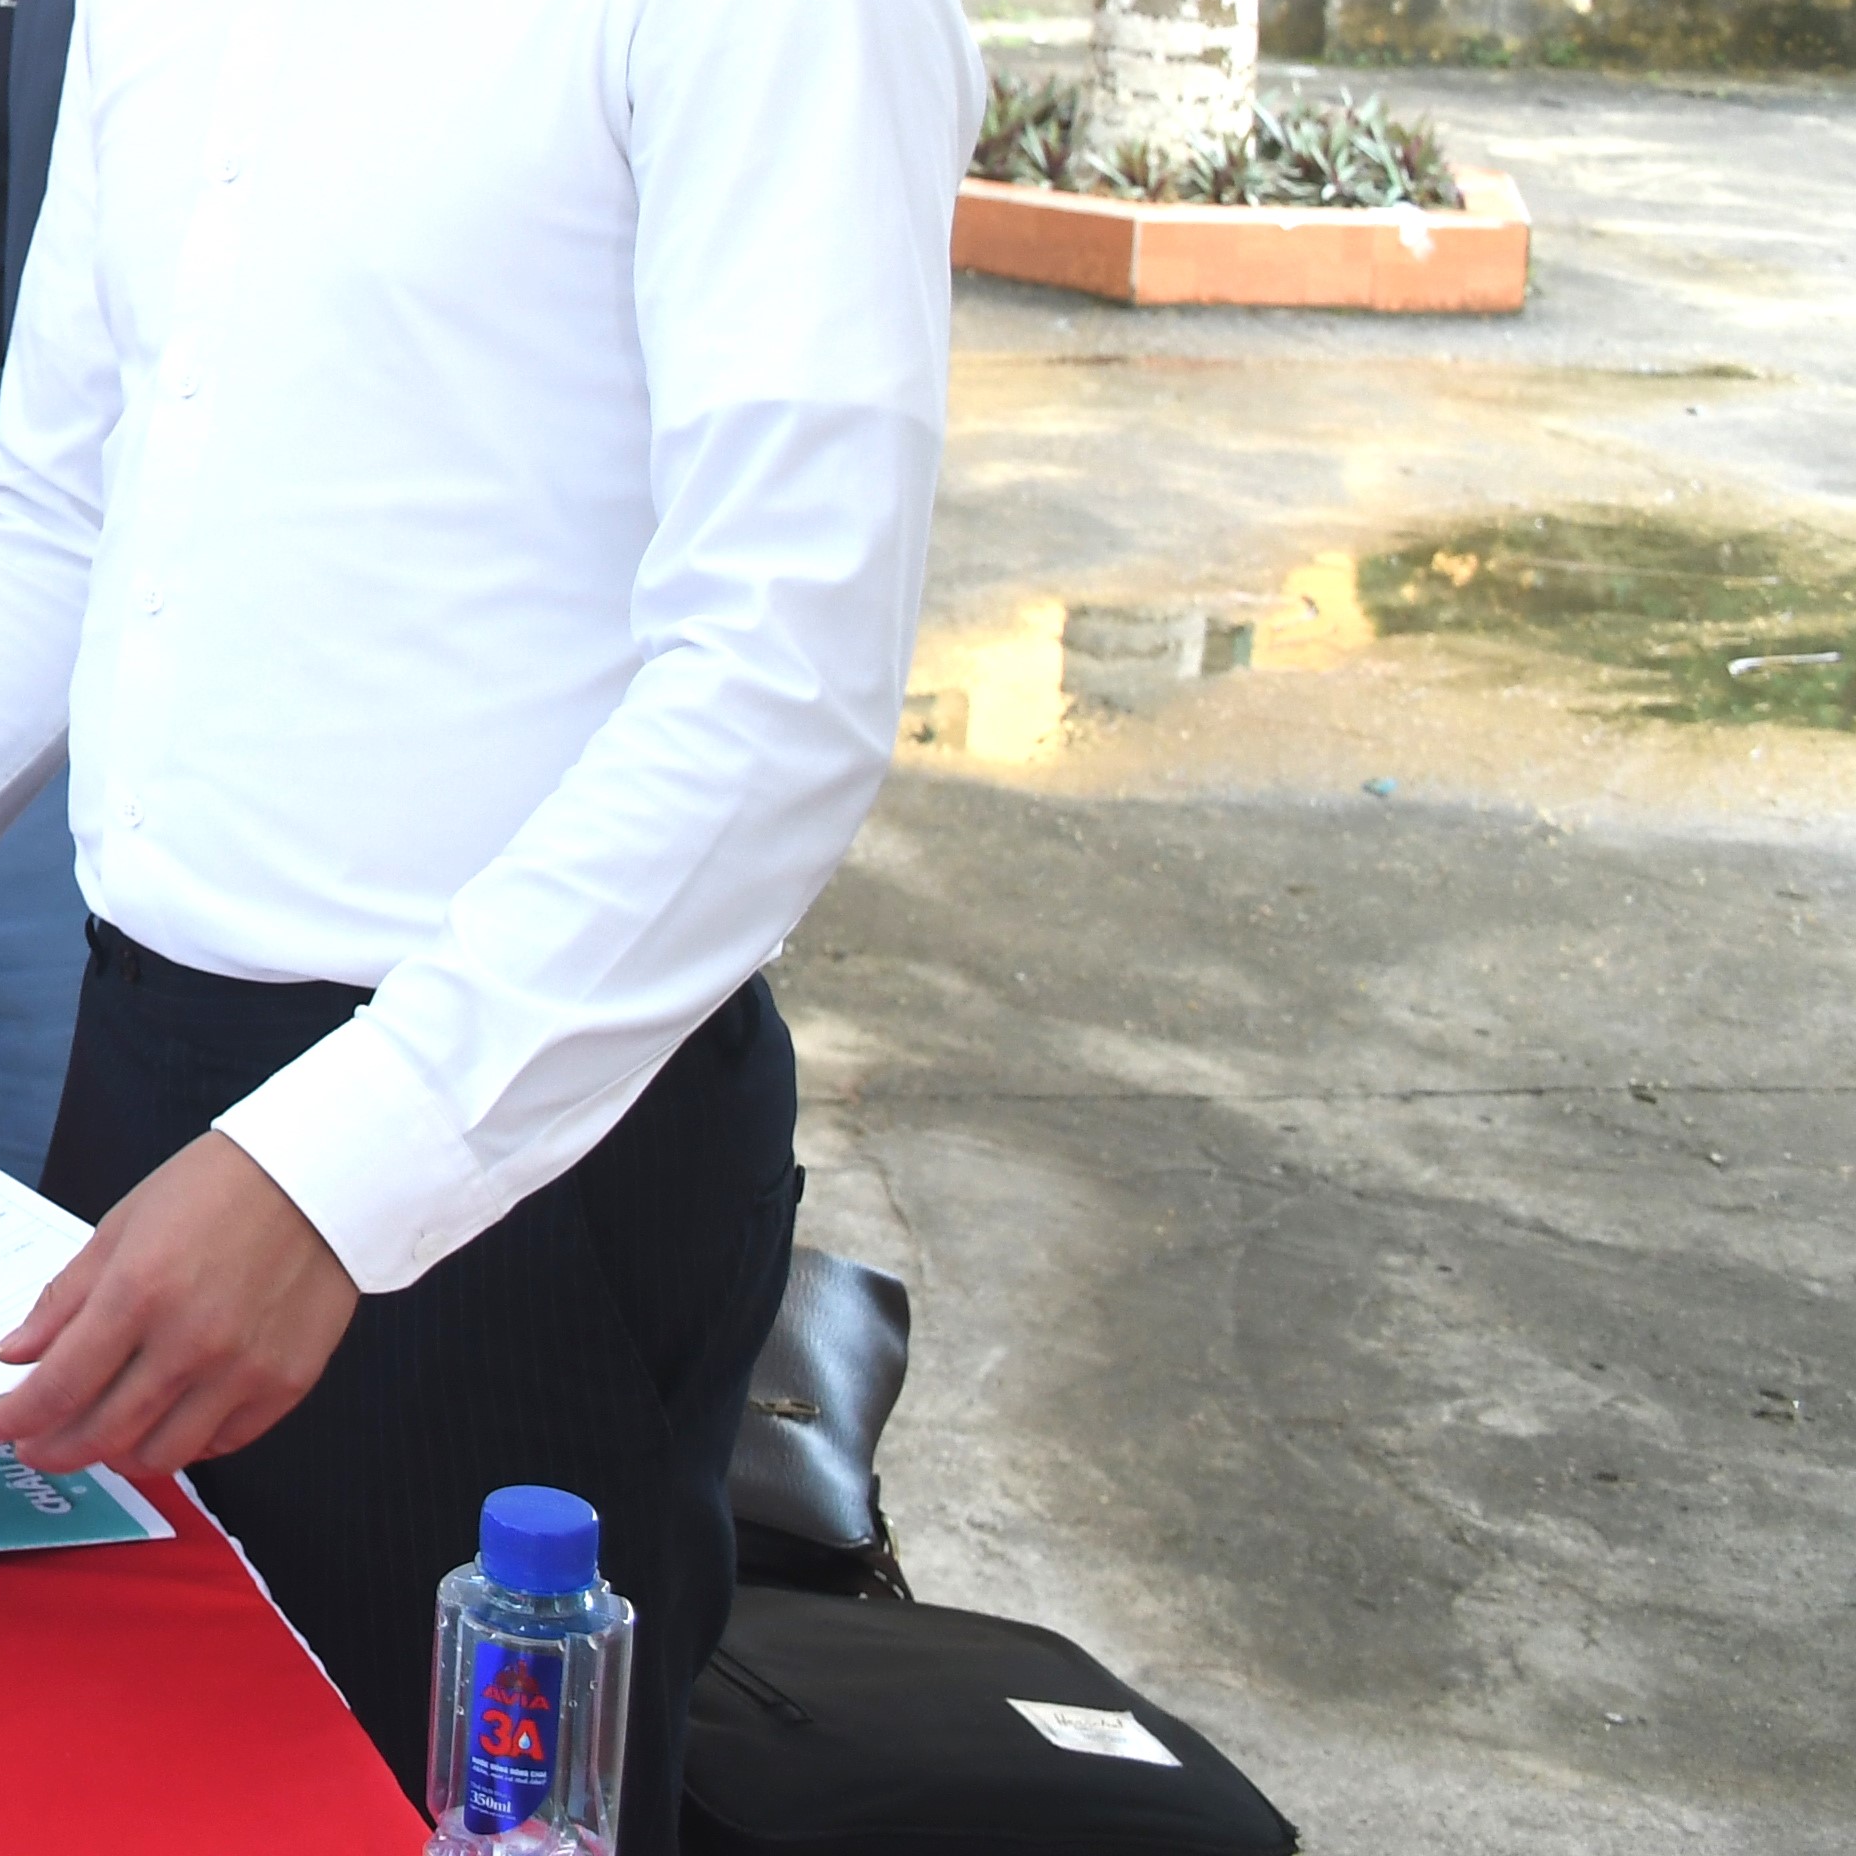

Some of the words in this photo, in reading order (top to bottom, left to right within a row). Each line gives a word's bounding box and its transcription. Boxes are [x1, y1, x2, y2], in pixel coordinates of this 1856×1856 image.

[482, 1685, 551, 1710] AVIA
[480, 1709, 545, 1762] 3A
[469, 1789, 513, 1813] 350ml
